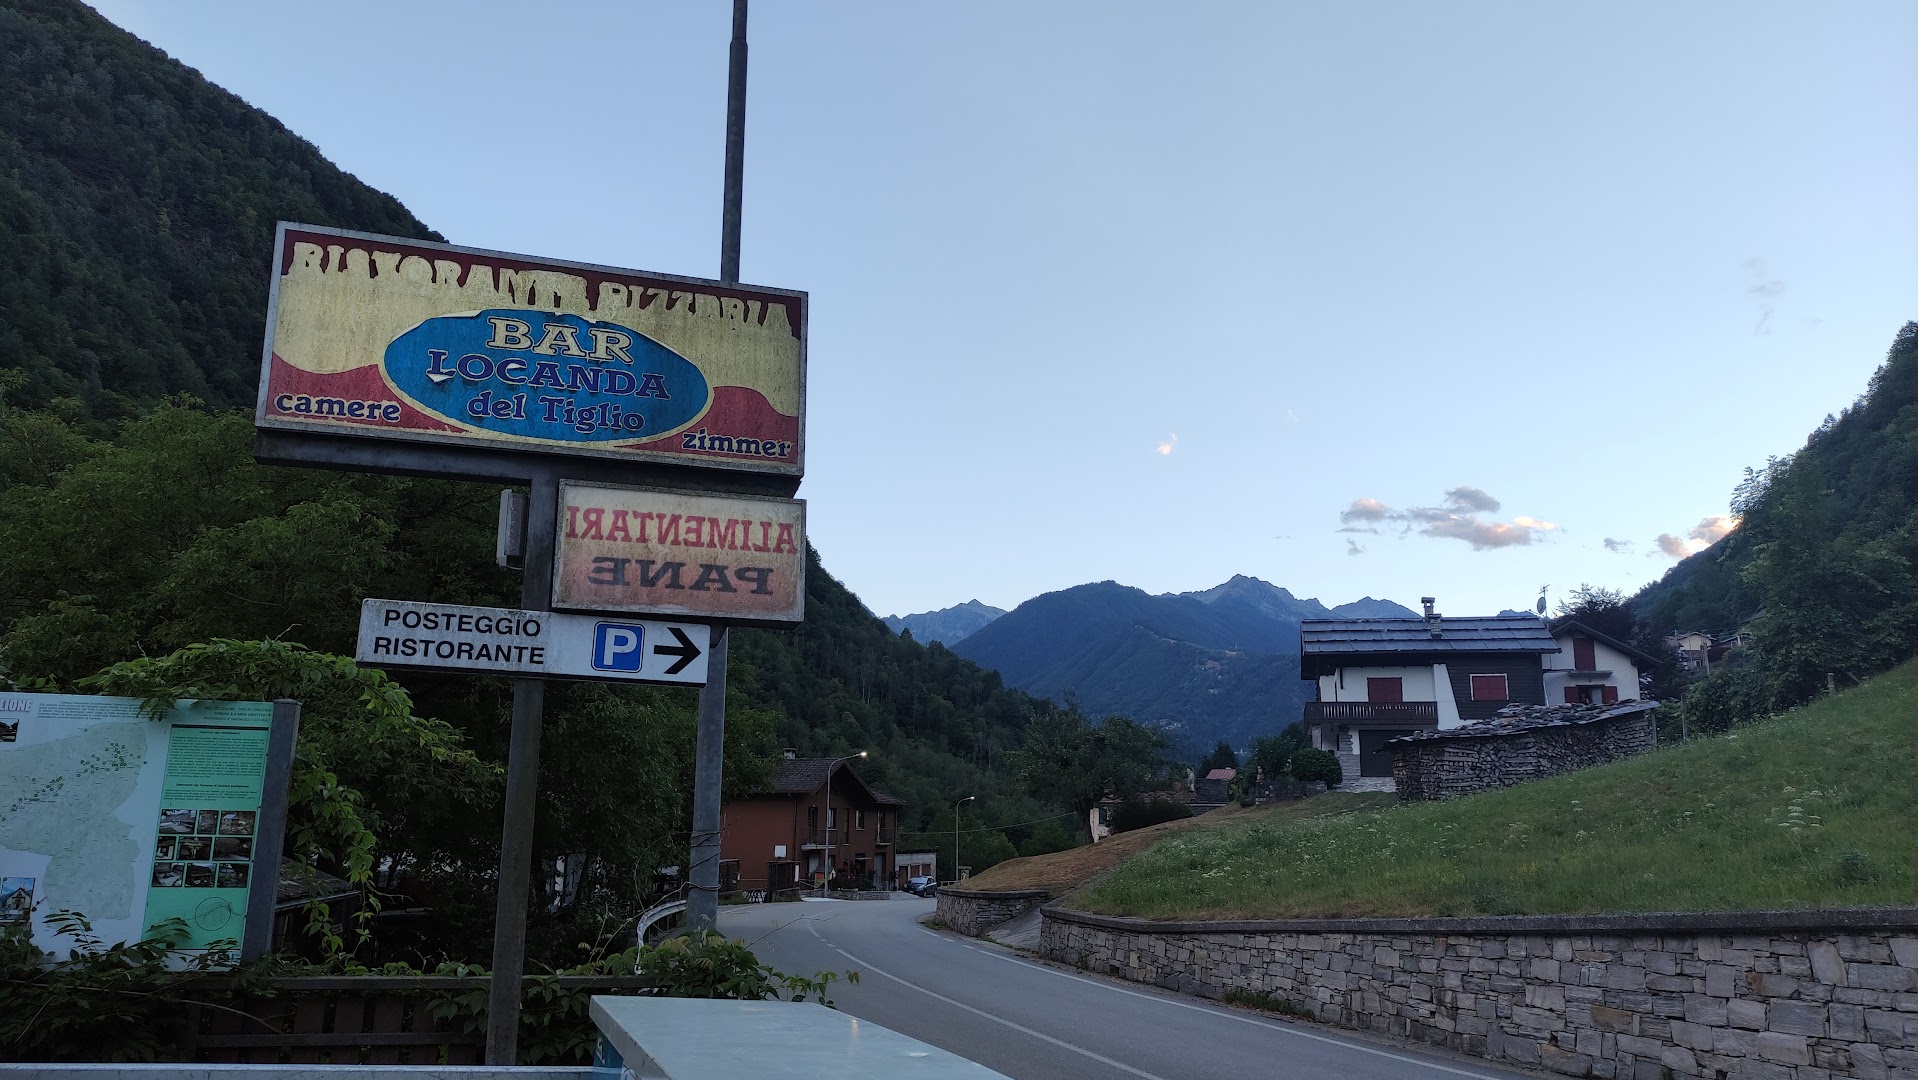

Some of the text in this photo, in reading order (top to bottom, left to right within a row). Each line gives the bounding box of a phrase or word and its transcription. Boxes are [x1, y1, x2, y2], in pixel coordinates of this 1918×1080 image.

[487, 317, 634, 364] BAR
[426, 350, 671, 400] LOCANDA
[275, 393, 401, 421] camere
[467, 391, 645, 433] del Tiglio
[682, 428, 791, 457] zimmer
[384, 609, 541, 637] POSTEGGIO
[373, 636, 545, 664] RISTORANTE
[604, 628, 637, 666] P
